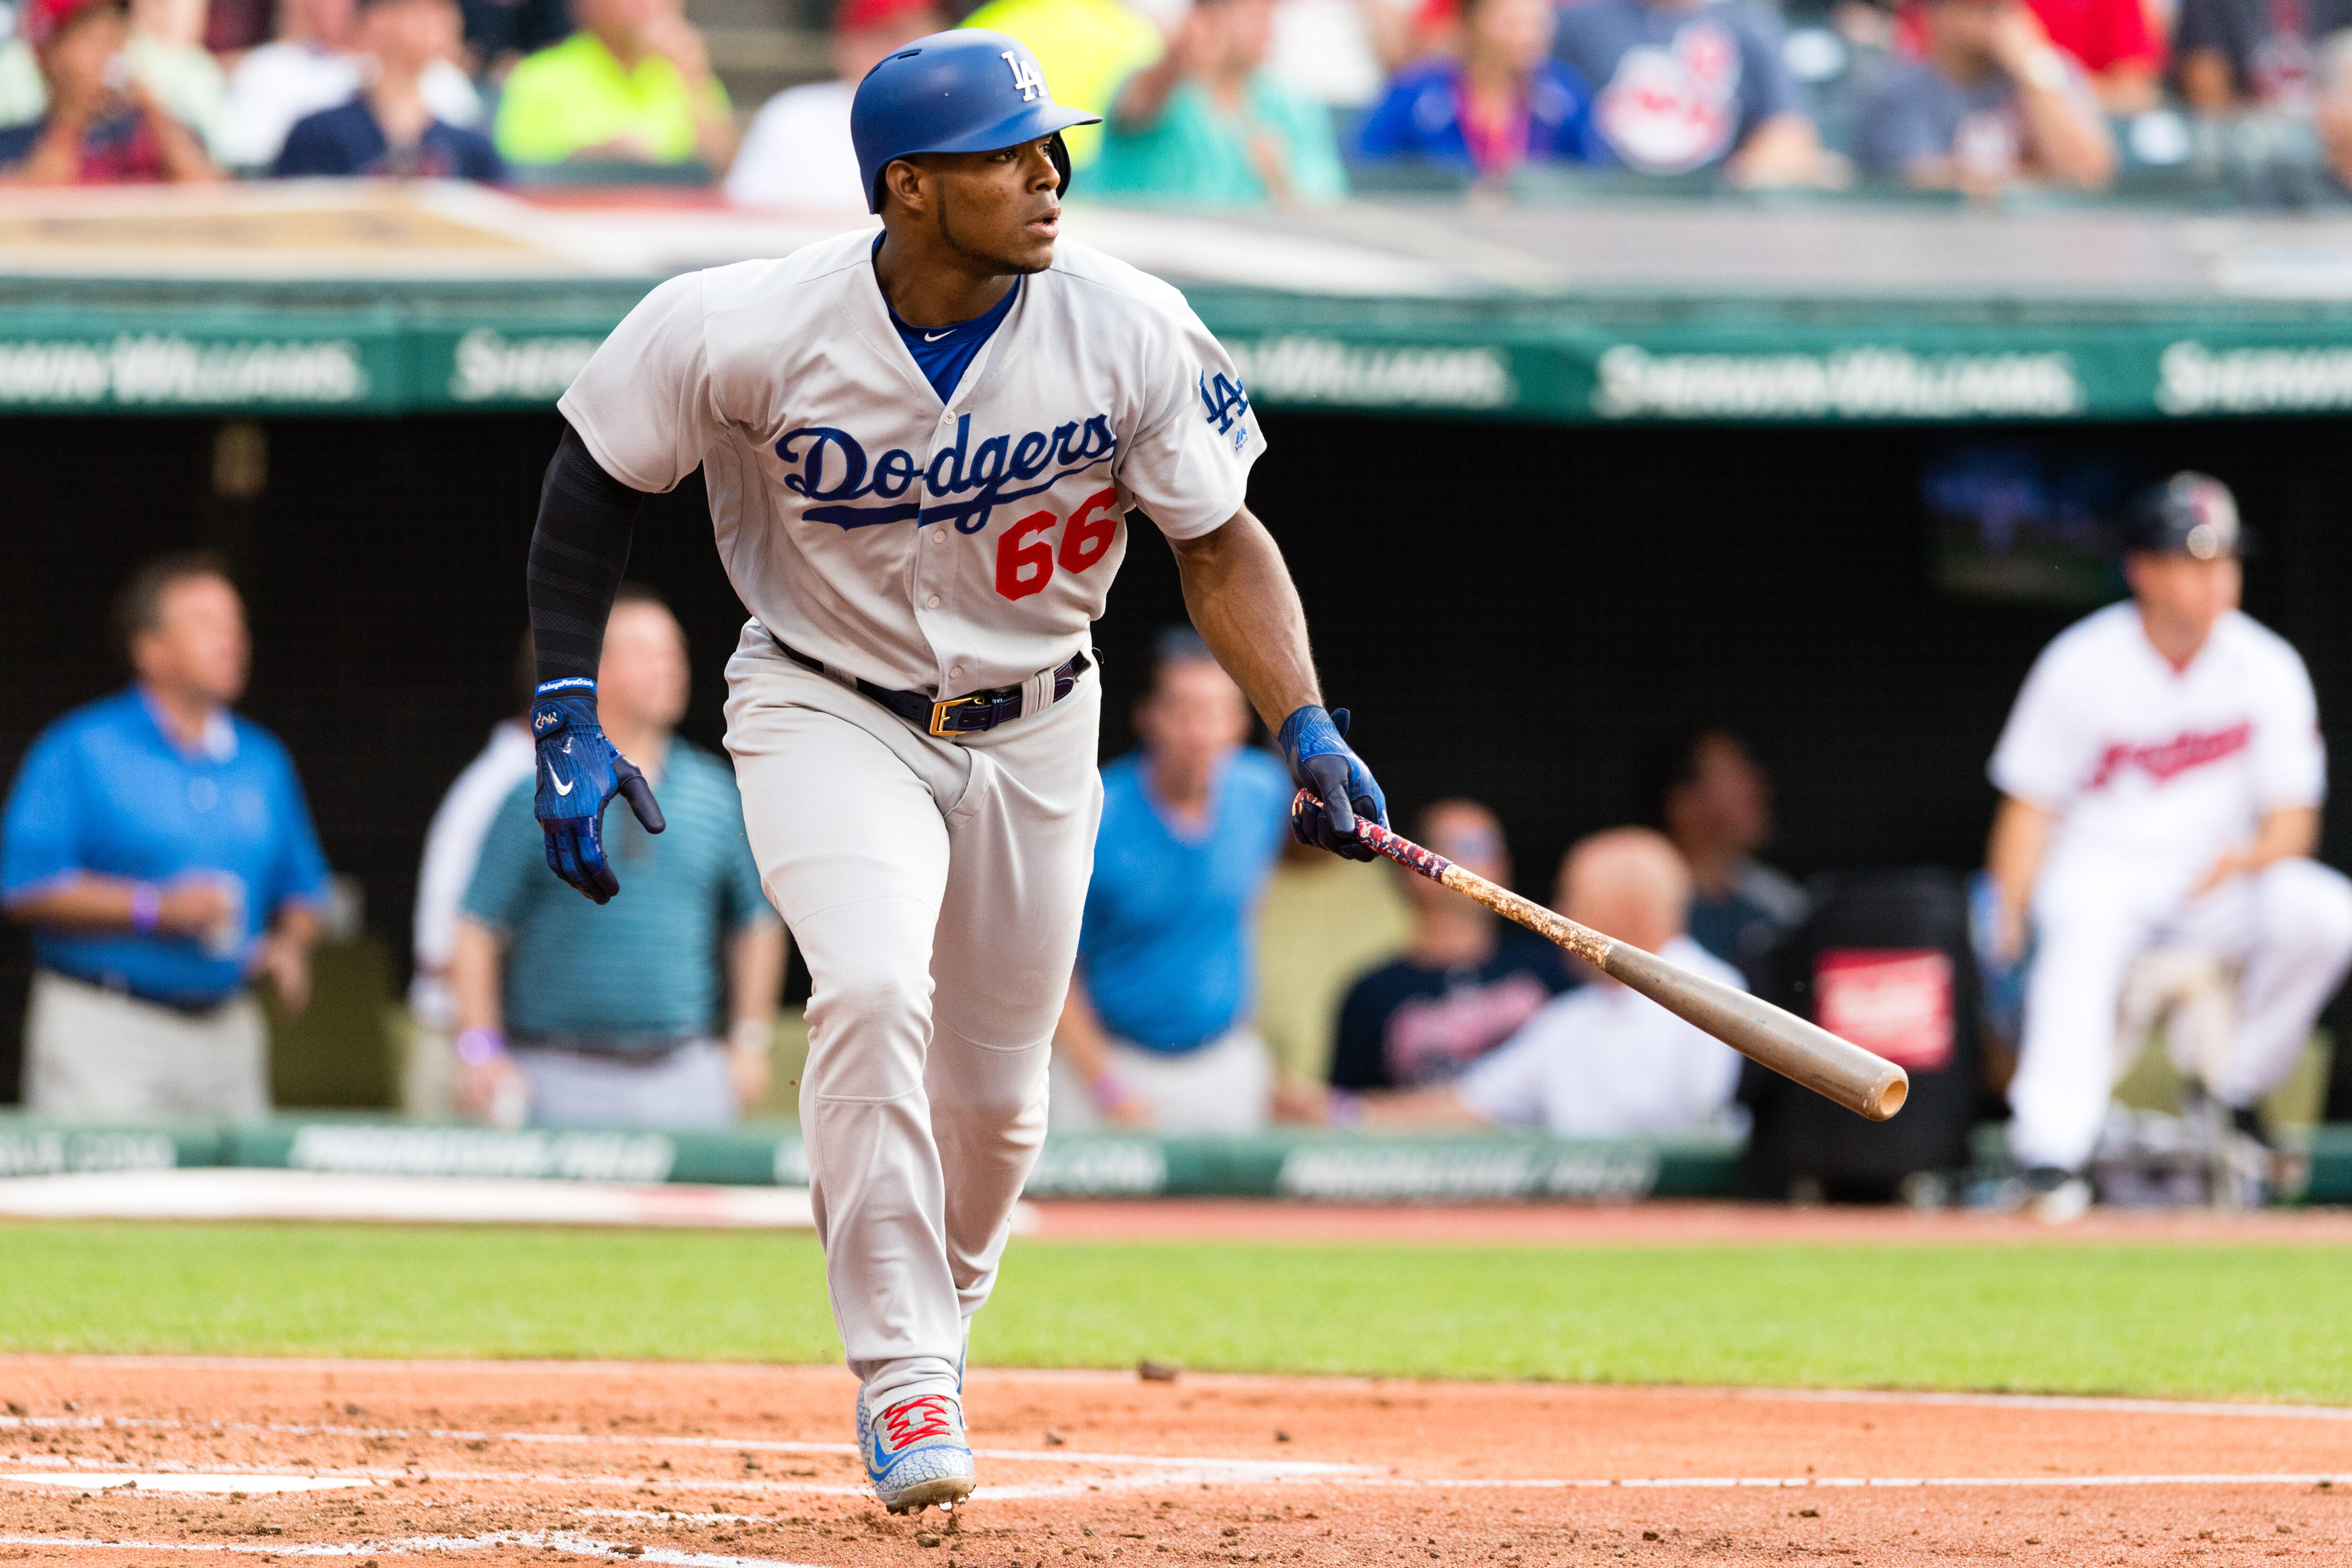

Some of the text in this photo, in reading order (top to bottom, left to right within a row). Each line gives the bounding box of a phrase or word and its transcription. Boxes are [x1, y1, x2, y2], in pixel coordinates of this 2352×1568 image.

[1001, 51, 1048, 102] LA
[1199, 368, 1249, 436] LA
[775, 413, 1117, 535] Dodgers
[996, 487, 1118, 601] 66
